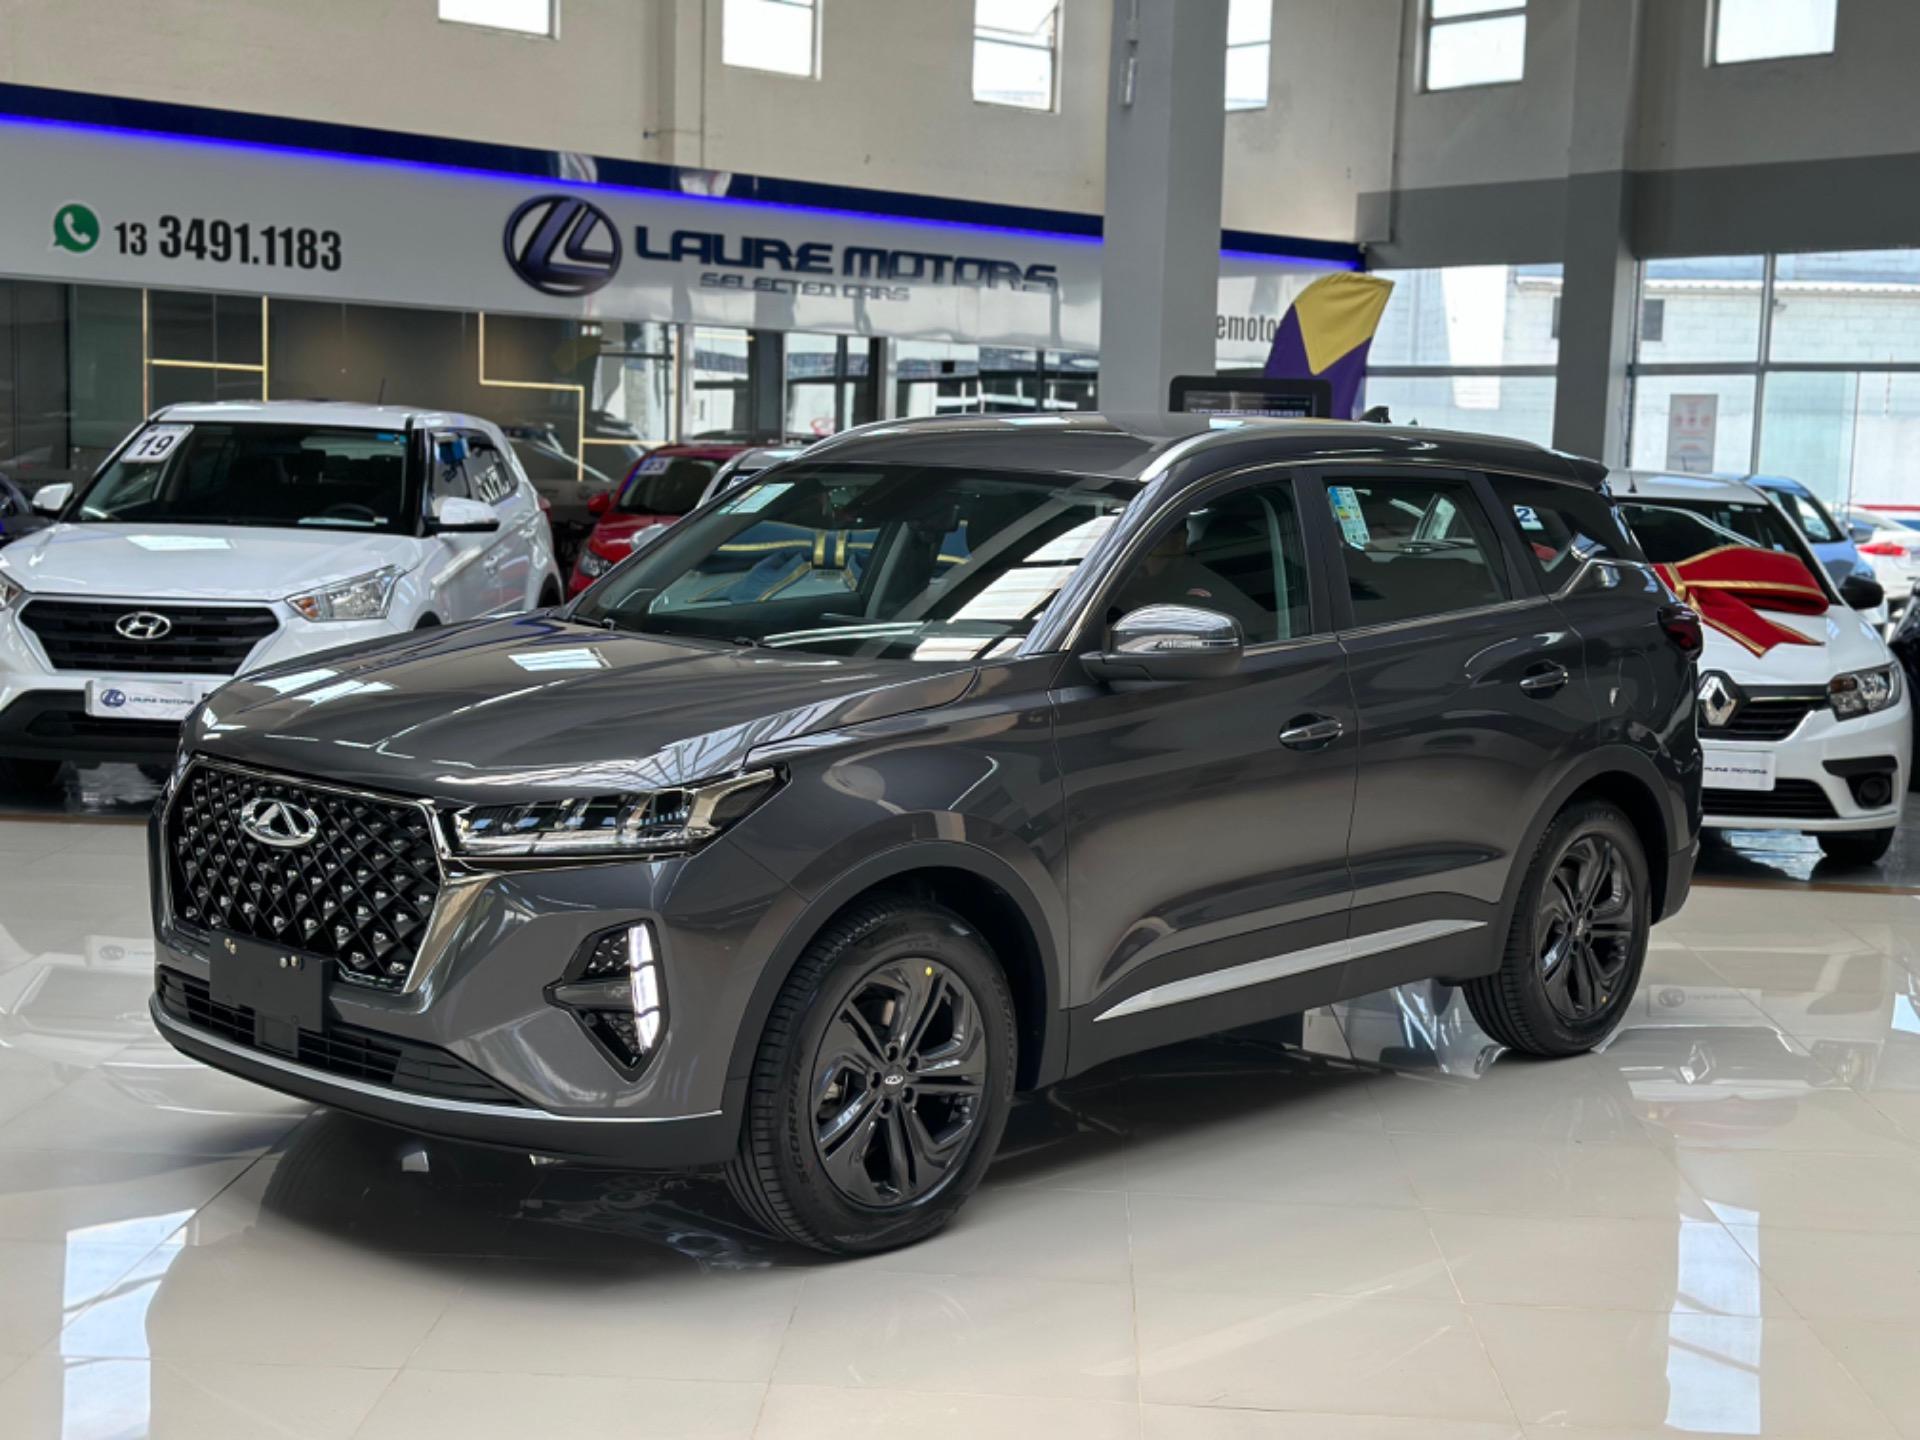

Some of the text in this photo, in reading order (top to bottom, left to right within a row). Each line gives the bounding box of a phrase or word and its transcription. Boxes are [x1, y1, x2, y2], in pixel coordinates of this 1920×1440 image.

[114, 215, 342, 271] 13 3491.1183
[634, 226, 1058, 292] LAURE MOTORS
[701, 272, 910, 301] SELECTED CARS
[136, 435, 175, 456] 19
